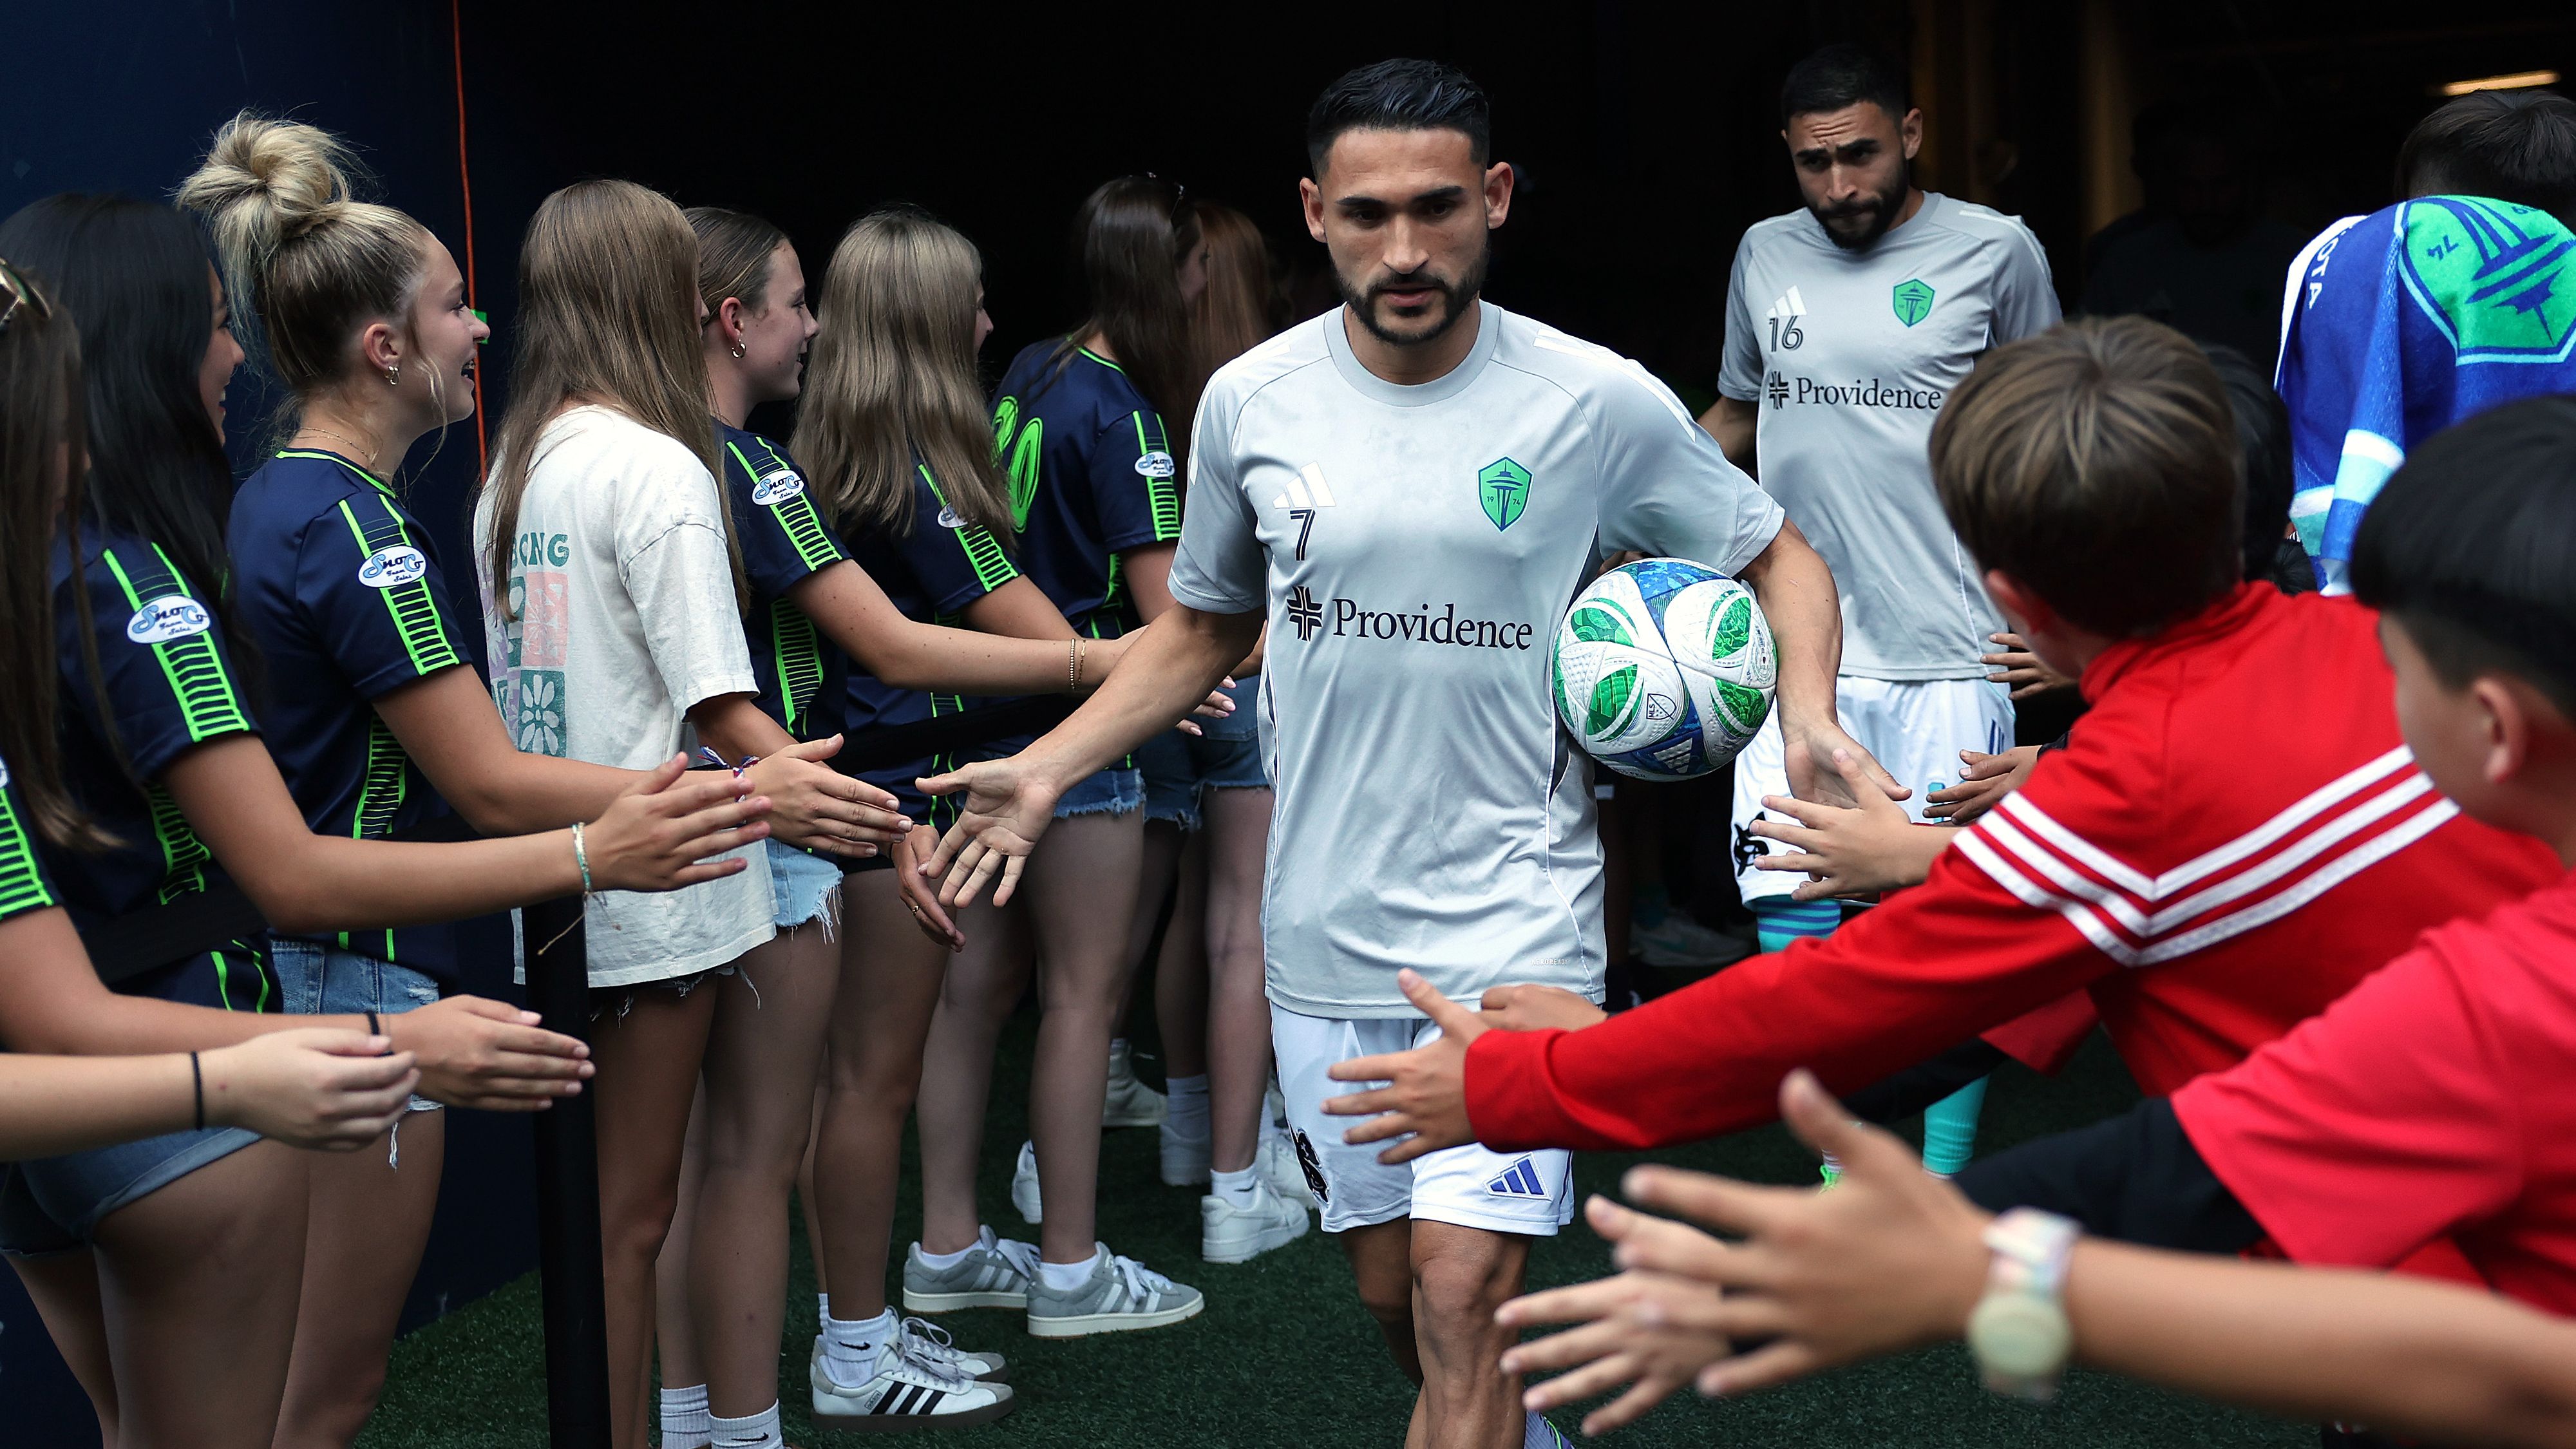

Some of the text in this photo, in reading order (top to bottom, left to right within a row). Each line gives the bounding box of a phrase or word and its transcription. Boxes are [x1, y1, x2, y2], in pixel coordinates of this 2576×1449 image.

[2309, 230, 2347, 309] OTA
[2427, 234, 2459, 261] 74
[1768, 315, 1804, 352] 16
[1795, 379, 1942, 410] Providence
[1290, 509, 1316, 561] 7
[1332, 598, 1533, 650] Providence
